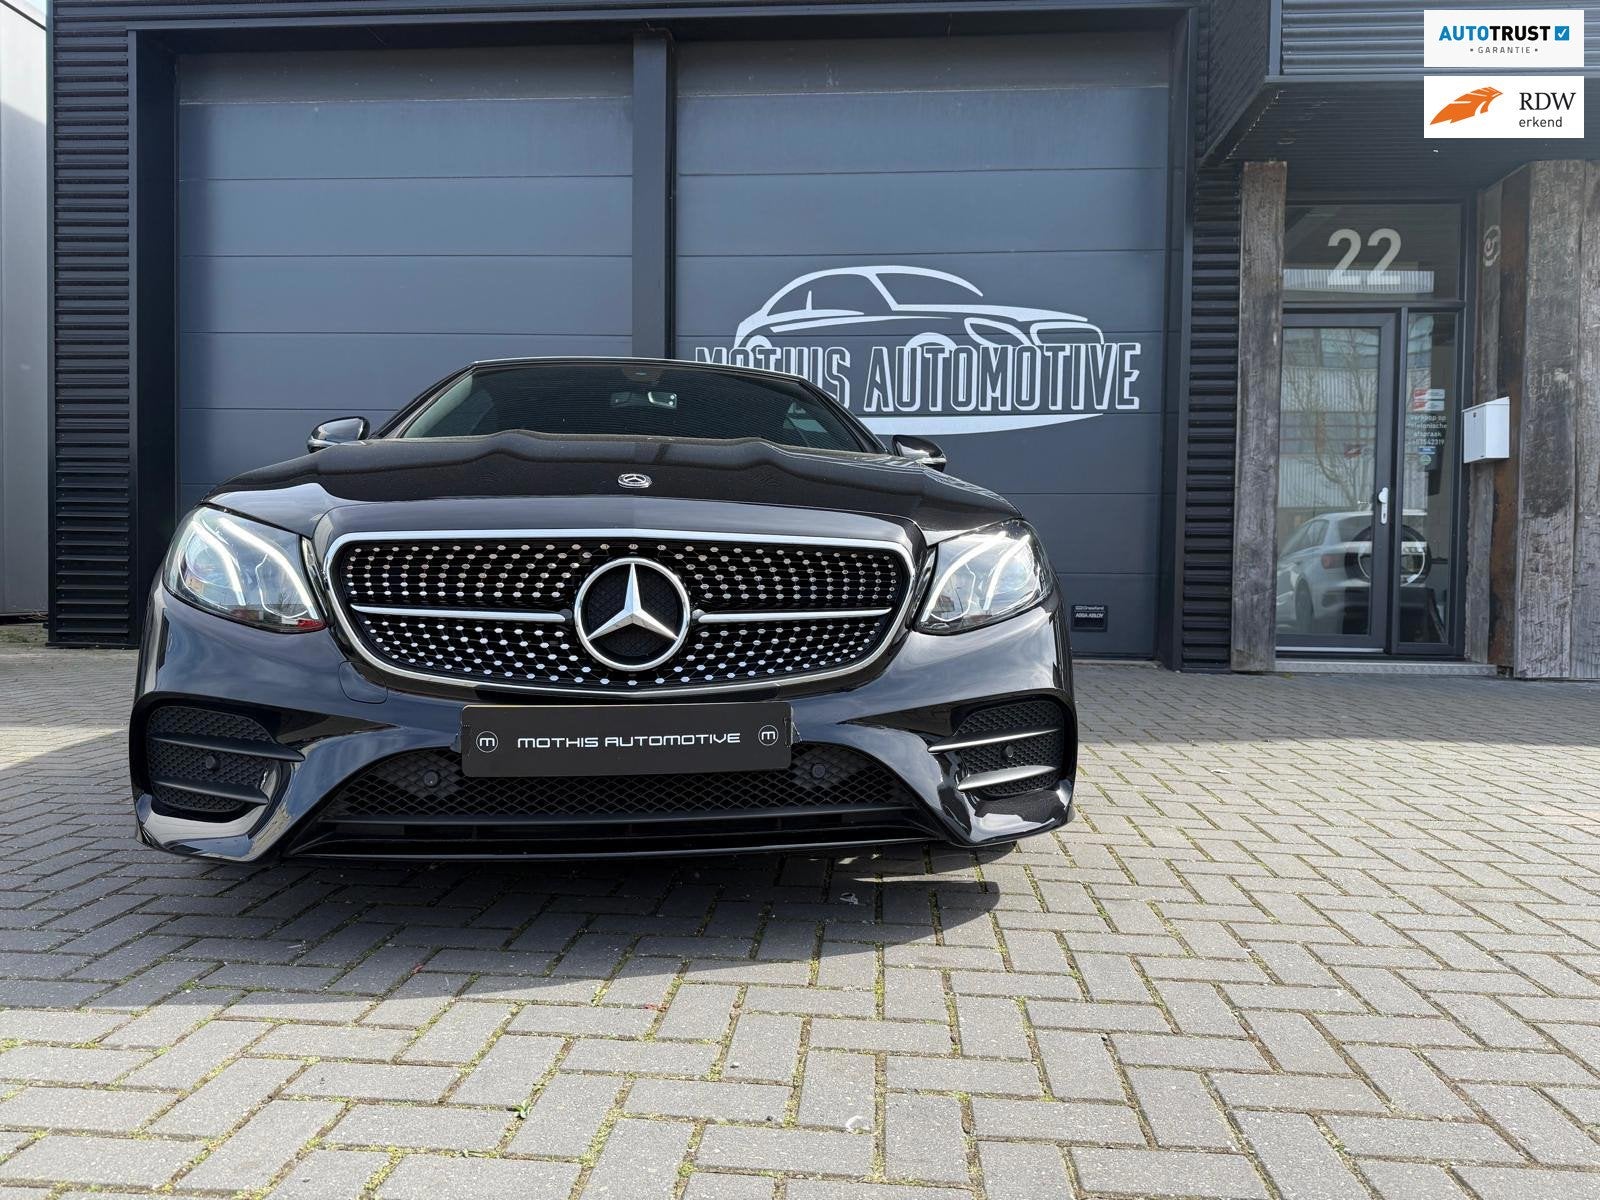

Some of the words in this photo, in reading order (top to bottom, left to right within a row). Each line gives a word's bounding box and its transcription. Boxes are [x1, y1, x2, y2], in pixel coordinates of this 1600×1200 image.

[1327, 228, 1402, 286] 22
[863, 342, 1141, 412] AUTOMOTIVE
[517, 737, 599, 749] MOTHIS
[604, 732, 741, 748] AUTOMOTIVE
